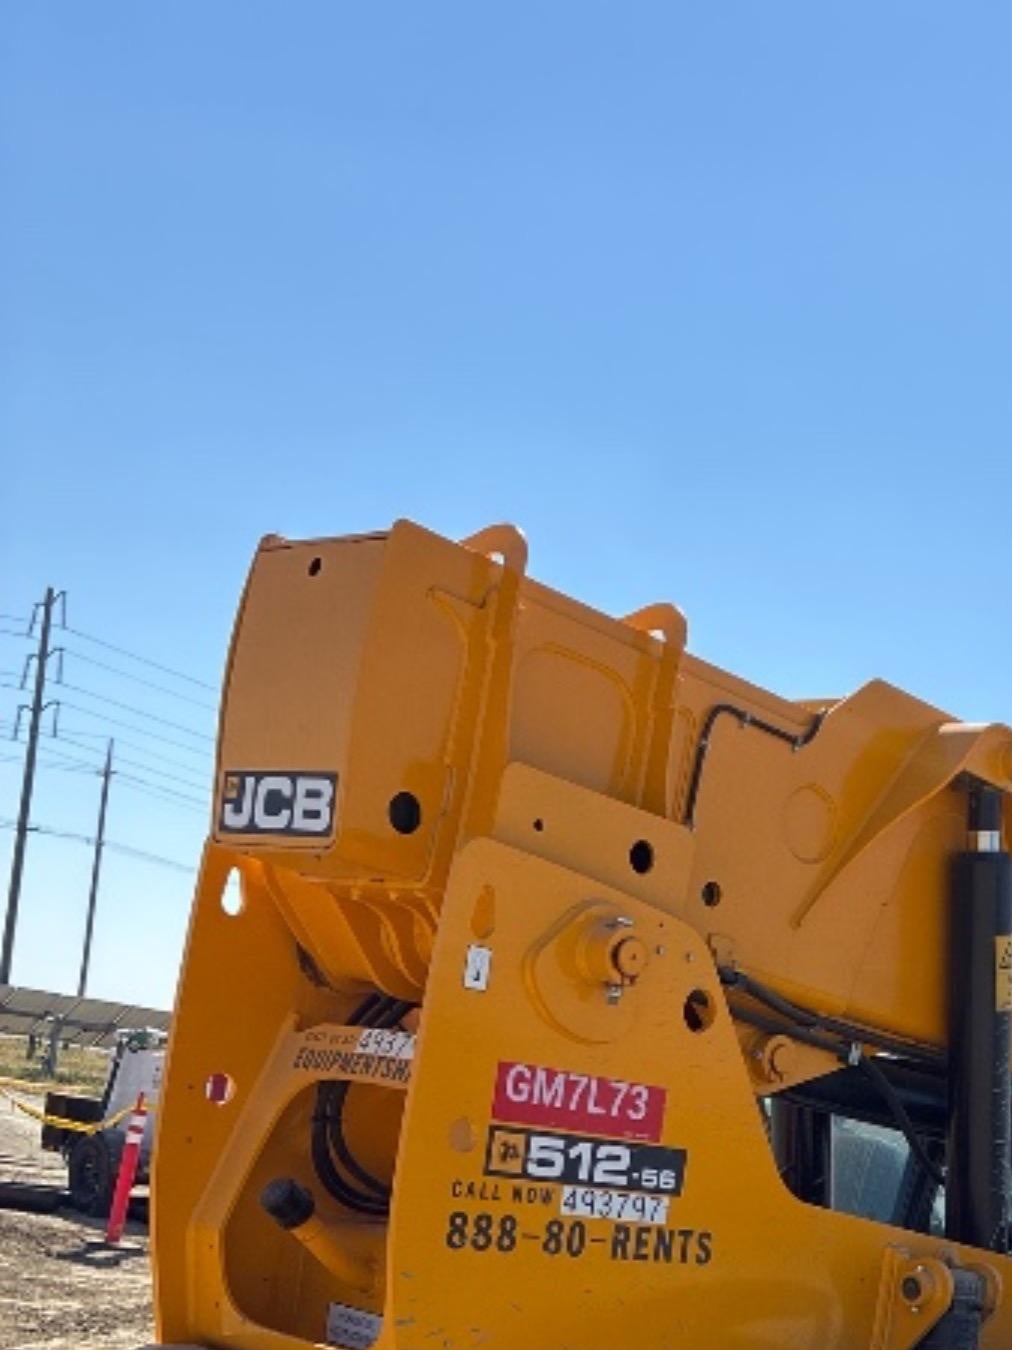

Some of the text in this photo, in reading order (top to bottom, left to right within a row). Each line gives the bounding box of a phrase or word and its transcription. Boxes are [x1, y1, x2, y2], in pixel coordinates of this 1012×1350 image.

[223, 776, 334, 832] JCB
[505, 1064, 649, 1120] GM7L73
[452, 1180, 555, 1205] CALL NOW
[563, 1188, 665, 1222] 493797
[446, 1211, 713, 1265] 888-80-RENTS
